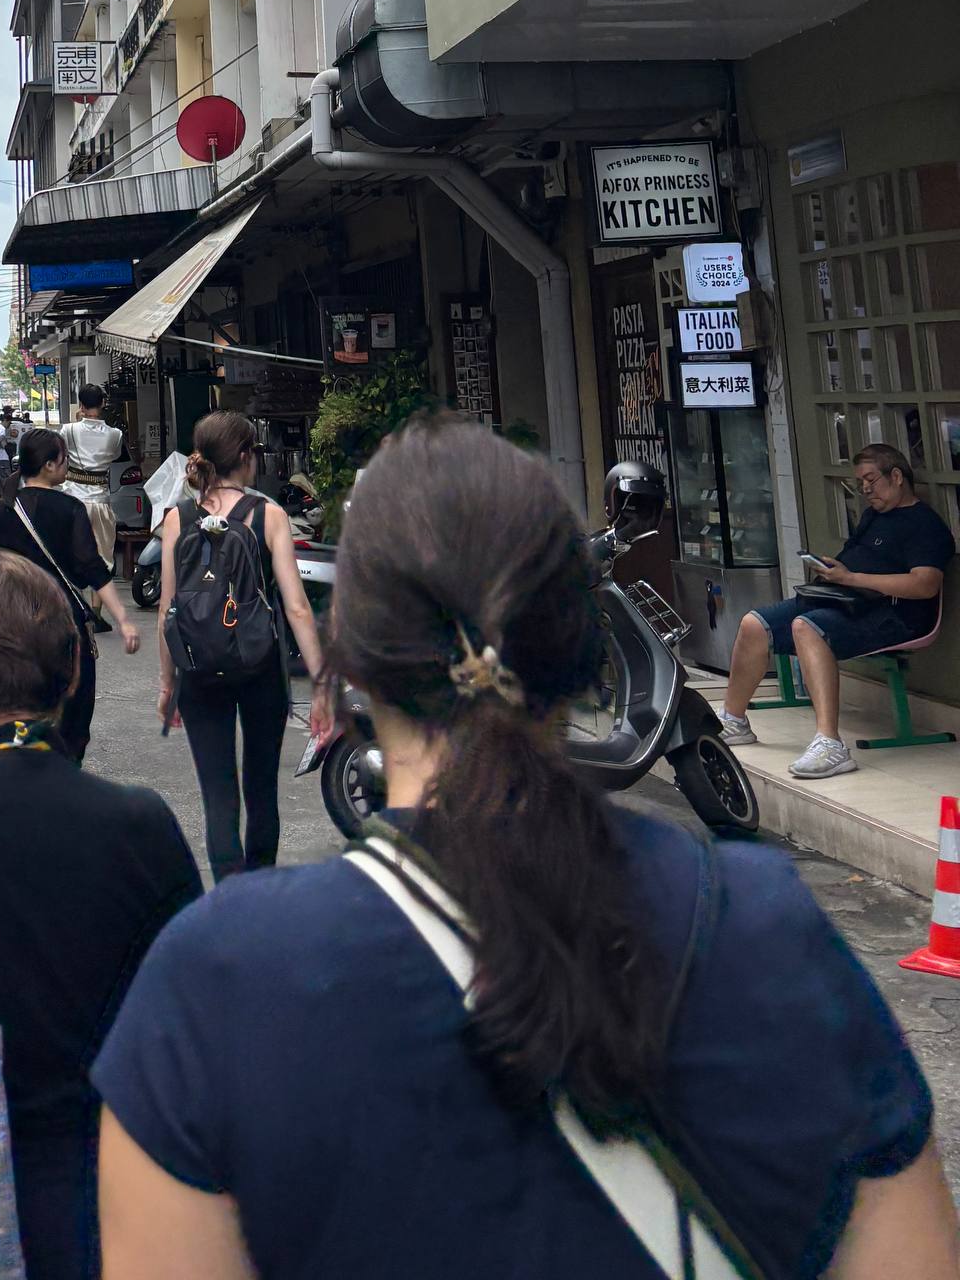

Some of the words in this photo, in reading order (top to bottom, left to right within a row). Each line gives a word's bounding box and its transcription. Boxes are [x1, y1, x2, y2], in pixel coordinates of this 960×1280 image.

[607, 160, 622, 171] IT'S
[623, 154, 672, 166] HAPPENED
[674, 155, 686, 163] TO
[688, 157, 700, 167] BE
[644, 173, 710, 191] PRINCESS
[603, 196, 716, 230] KITCHEN
[702, 272, 737, 280] CHOICE
[704, 263, 735, 272] USERS'
[613, 303, 645, 336] PASTA
[685, 311, 741, 330] ITALIAN
[696, 332, 735, 350] FOOD
[616, 337, 646, 369] PIZZA
[685, 377, 751, 394] 意大利菜
[617, 405, 656, 435] ITALIAN
